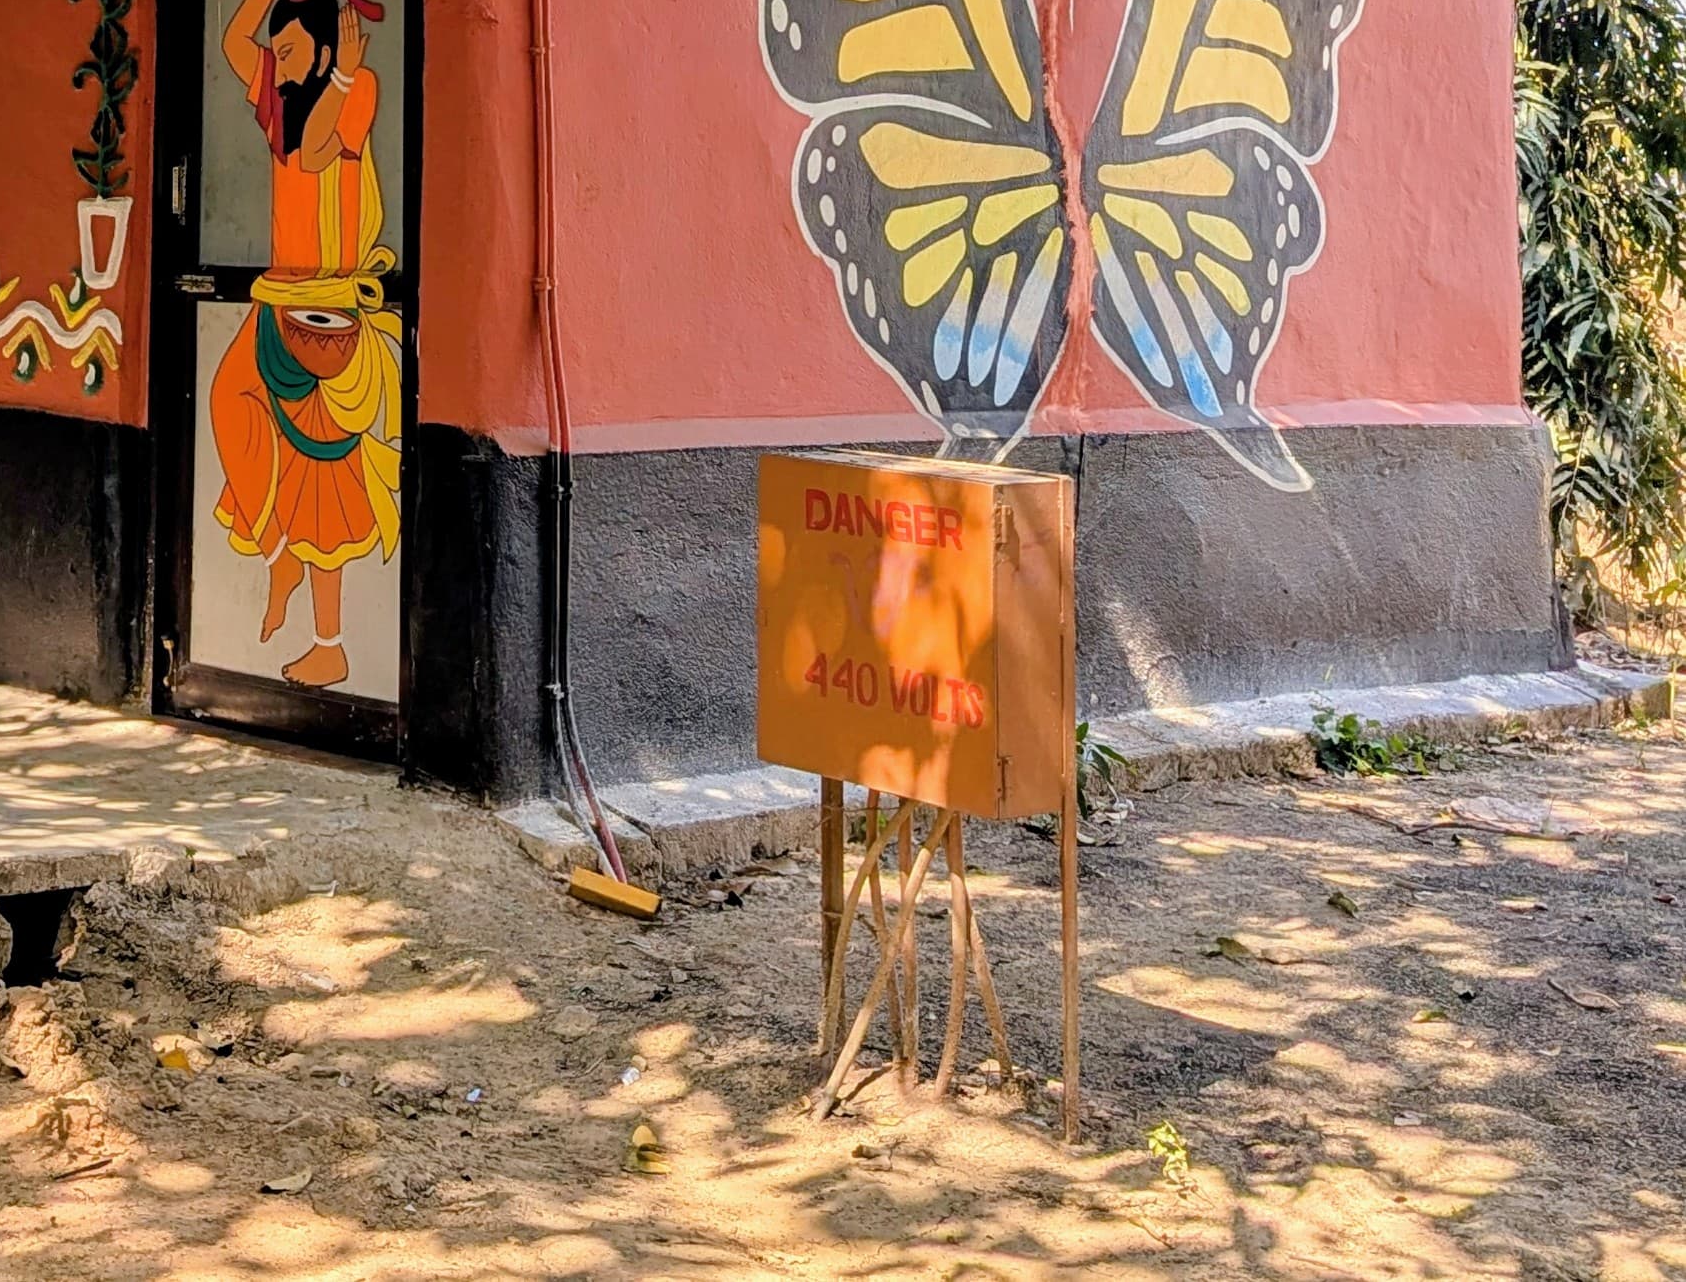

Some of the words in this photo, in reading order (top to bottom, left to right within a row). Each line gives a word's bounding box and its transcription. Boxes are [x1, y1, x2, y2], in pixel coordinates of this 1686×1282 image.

[804, 488, 963, 551] DANGER
[804, 652, 879, 707] 440
[889, 666, 985, 729] VOLTS
